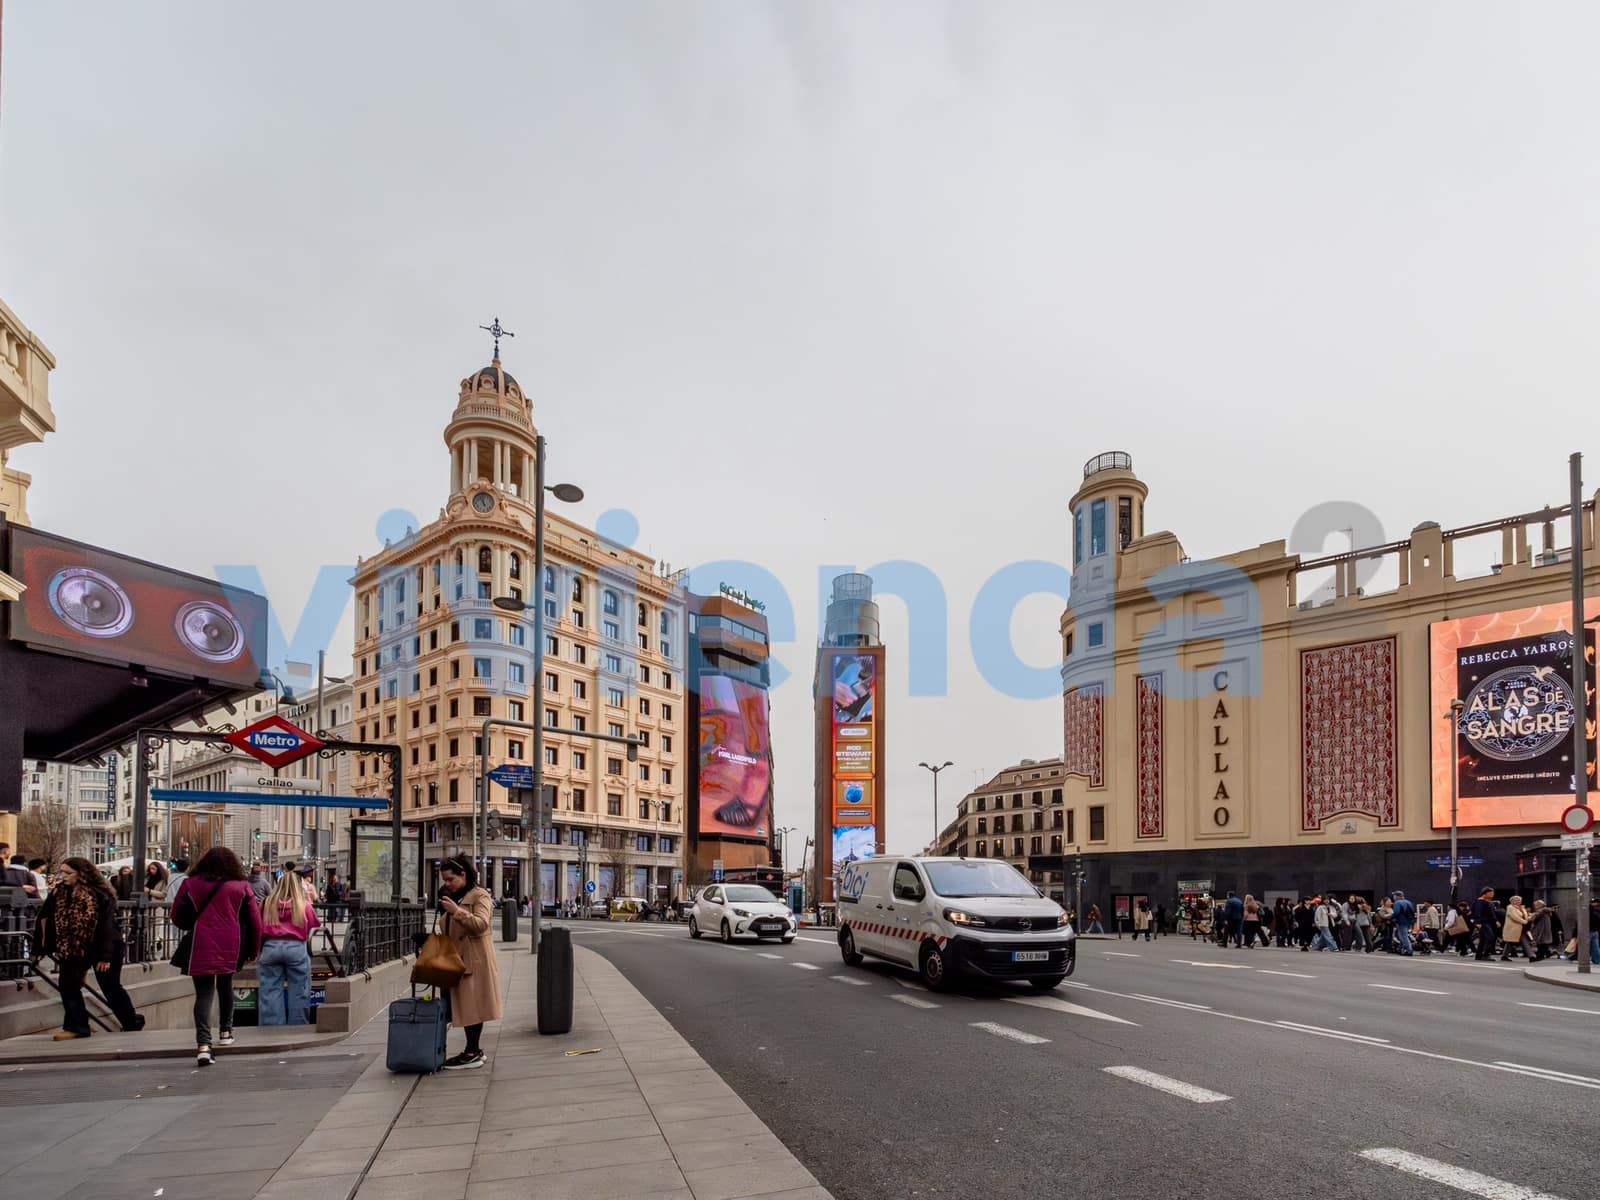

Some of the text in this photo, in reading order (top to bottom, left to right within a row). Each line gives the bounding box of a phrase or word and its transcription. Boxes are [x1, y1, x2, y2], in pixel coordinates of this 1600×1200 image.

[1460, 639, 1575, 666] REBECCA YARROS
[1469, 686, 1564, 714] ALAS DE
[1467, 710, 1570, 740] SANGRE
[254, 733, 296, 747] Metro
[1213, 670, 1230, 827] CALLAO
[257, 777, 293, 788] Callao
[310, 990, 326, 999] Call
